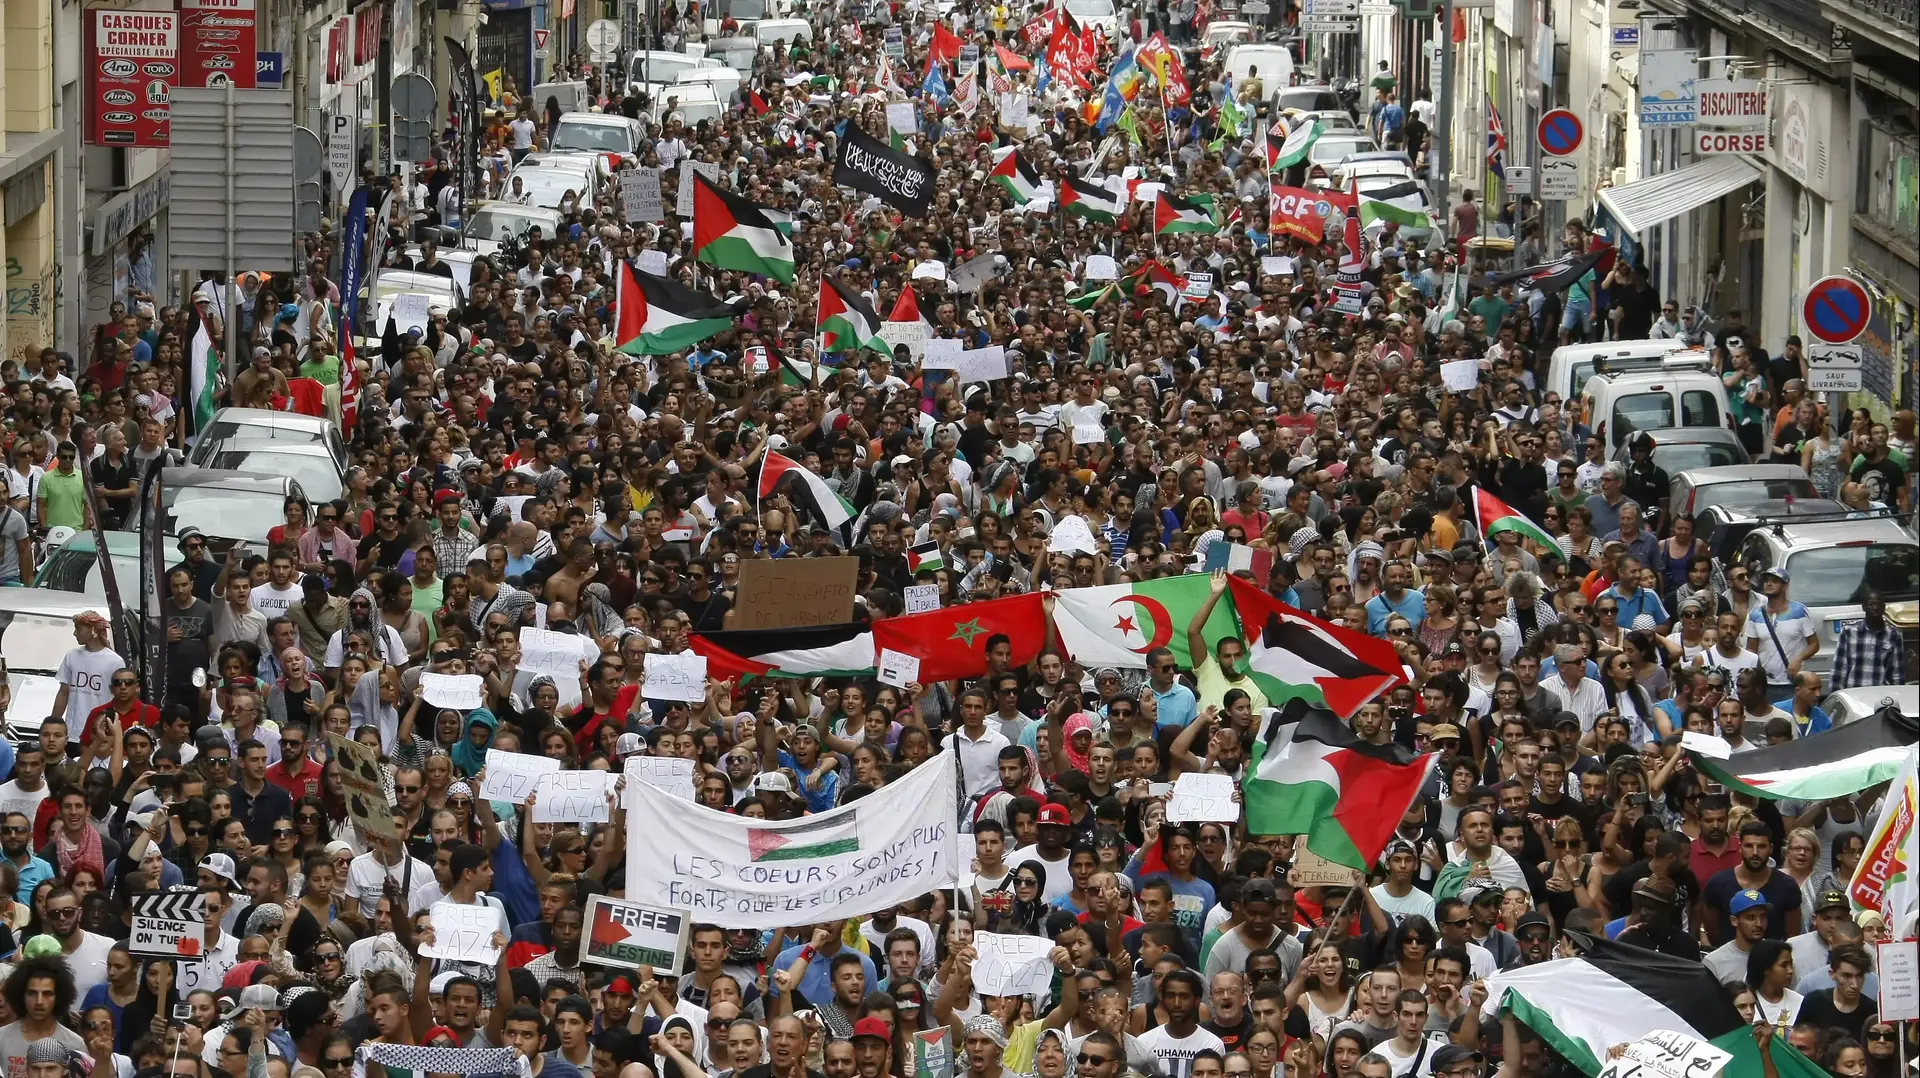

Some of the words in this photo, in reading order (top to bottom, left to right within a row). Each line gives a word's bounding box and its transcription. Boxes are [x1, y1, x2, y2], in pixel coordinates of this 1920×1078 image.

[103, 14, 172, 30] CASQUES
[108, 32, 167, 46] CORNER
[100, 46, 151, 55] SPÉCIALISTE
[154, 48, 174, 57] ARAI
[102, 60, 134, 74] Arai
[146, 64, 171, 74] TORX
[1643, 104, 1695, 113] SNACK
[1700, 92, 1766, 116] BISCUITERIE
[335, 116, 347, 134] P
[1700, 135, 1765, 152] CORSE
[623, 170, 656, 178] ISRAEL
[1338, 289, 1360, 297] JUSTICE
[260, 597, 293, 609] BROOKLY
[522, 629, 566, 648] FREE
[646, 672, 691, 686] GAZA
[488, 753, 539, 771] FREE
[626, 757, 685, 778] FREE
[486, 770, 527, 799] GAZ
[535, 771, 592, 791] FREE
[548, 796, 606, 818] GAZA
[1178, 796, 1231, 818] GAZA
[673, 854, 725, 880] LES
[739, 865, 837, 884] COEURS
[852, 838, 910, 876] SONT
[912, 821, 945, 845] PLUS
[670, 880, 727, 912] FORTS
[737, 892, 775, 914] QUE
[785, 895, 819, 911] LES
[431, 904, 489, 928] FREE
[609, 905, 669, 932] FREE
[137, 918, 186, 933] SILENCE
[136, 932, 153, 944] ON
[429, 927, 498, 957] GAZA
[976, 933, 1033, 955] FREE
[588, 939, 673, 966] PALESTINE
[986, 958, 1049, 990] GAZA
[1153, 1048, 1197, 1058] UHAMM
